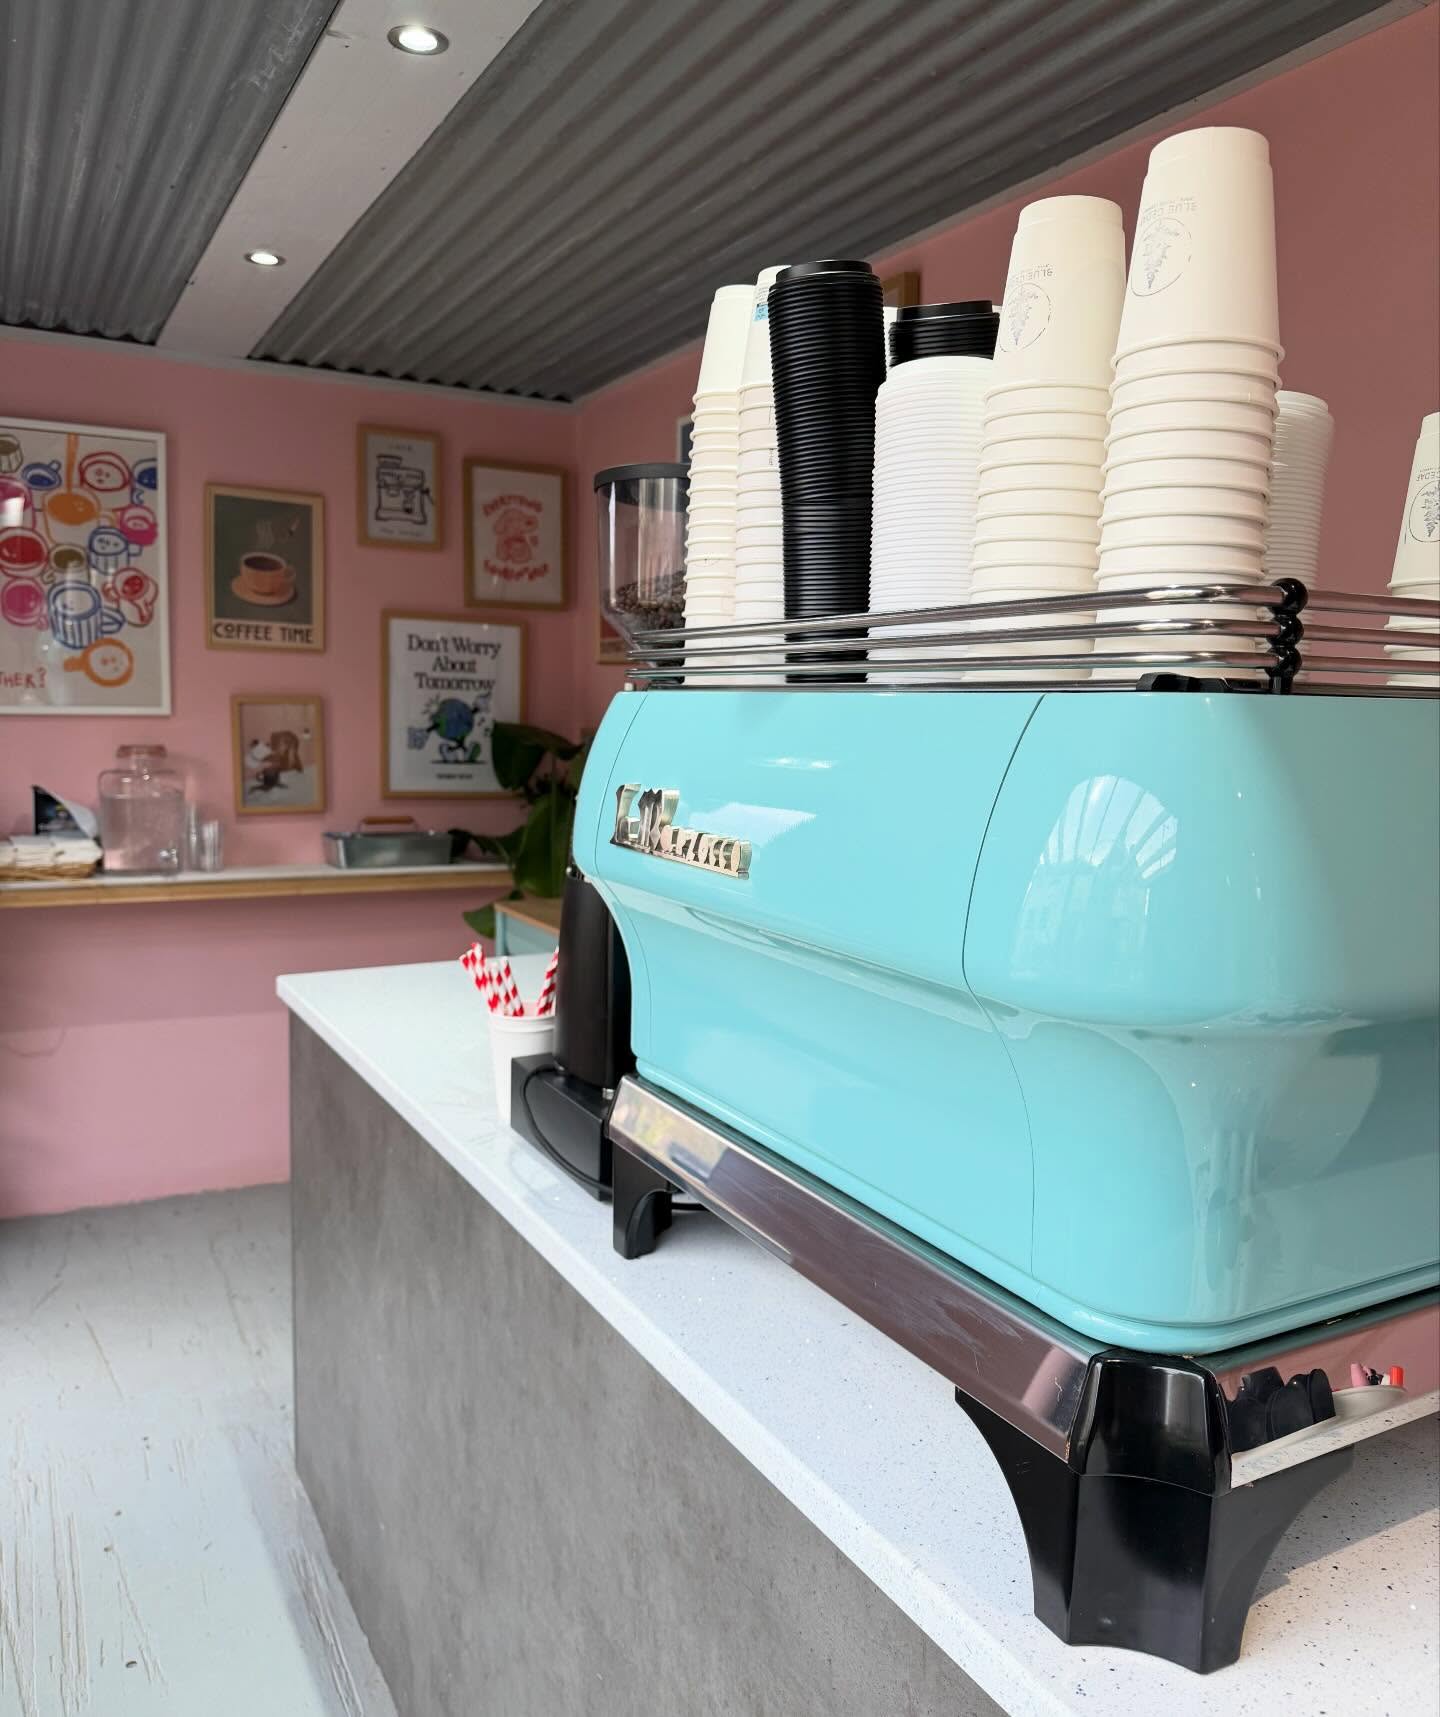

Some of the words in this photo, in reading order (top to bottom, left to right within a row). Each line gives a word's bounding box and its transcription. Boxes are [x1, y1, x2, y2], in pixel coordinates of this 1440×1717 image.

[214, 622, 273, 641] COFFEE
[279, 626, 313, 644] TIME
[407, 634, 449, 651] Don't
[451, 636, 502, 660] Worry
[432, 656, 477, 673] About
[414, 672, 496, 691] Tomorrow
